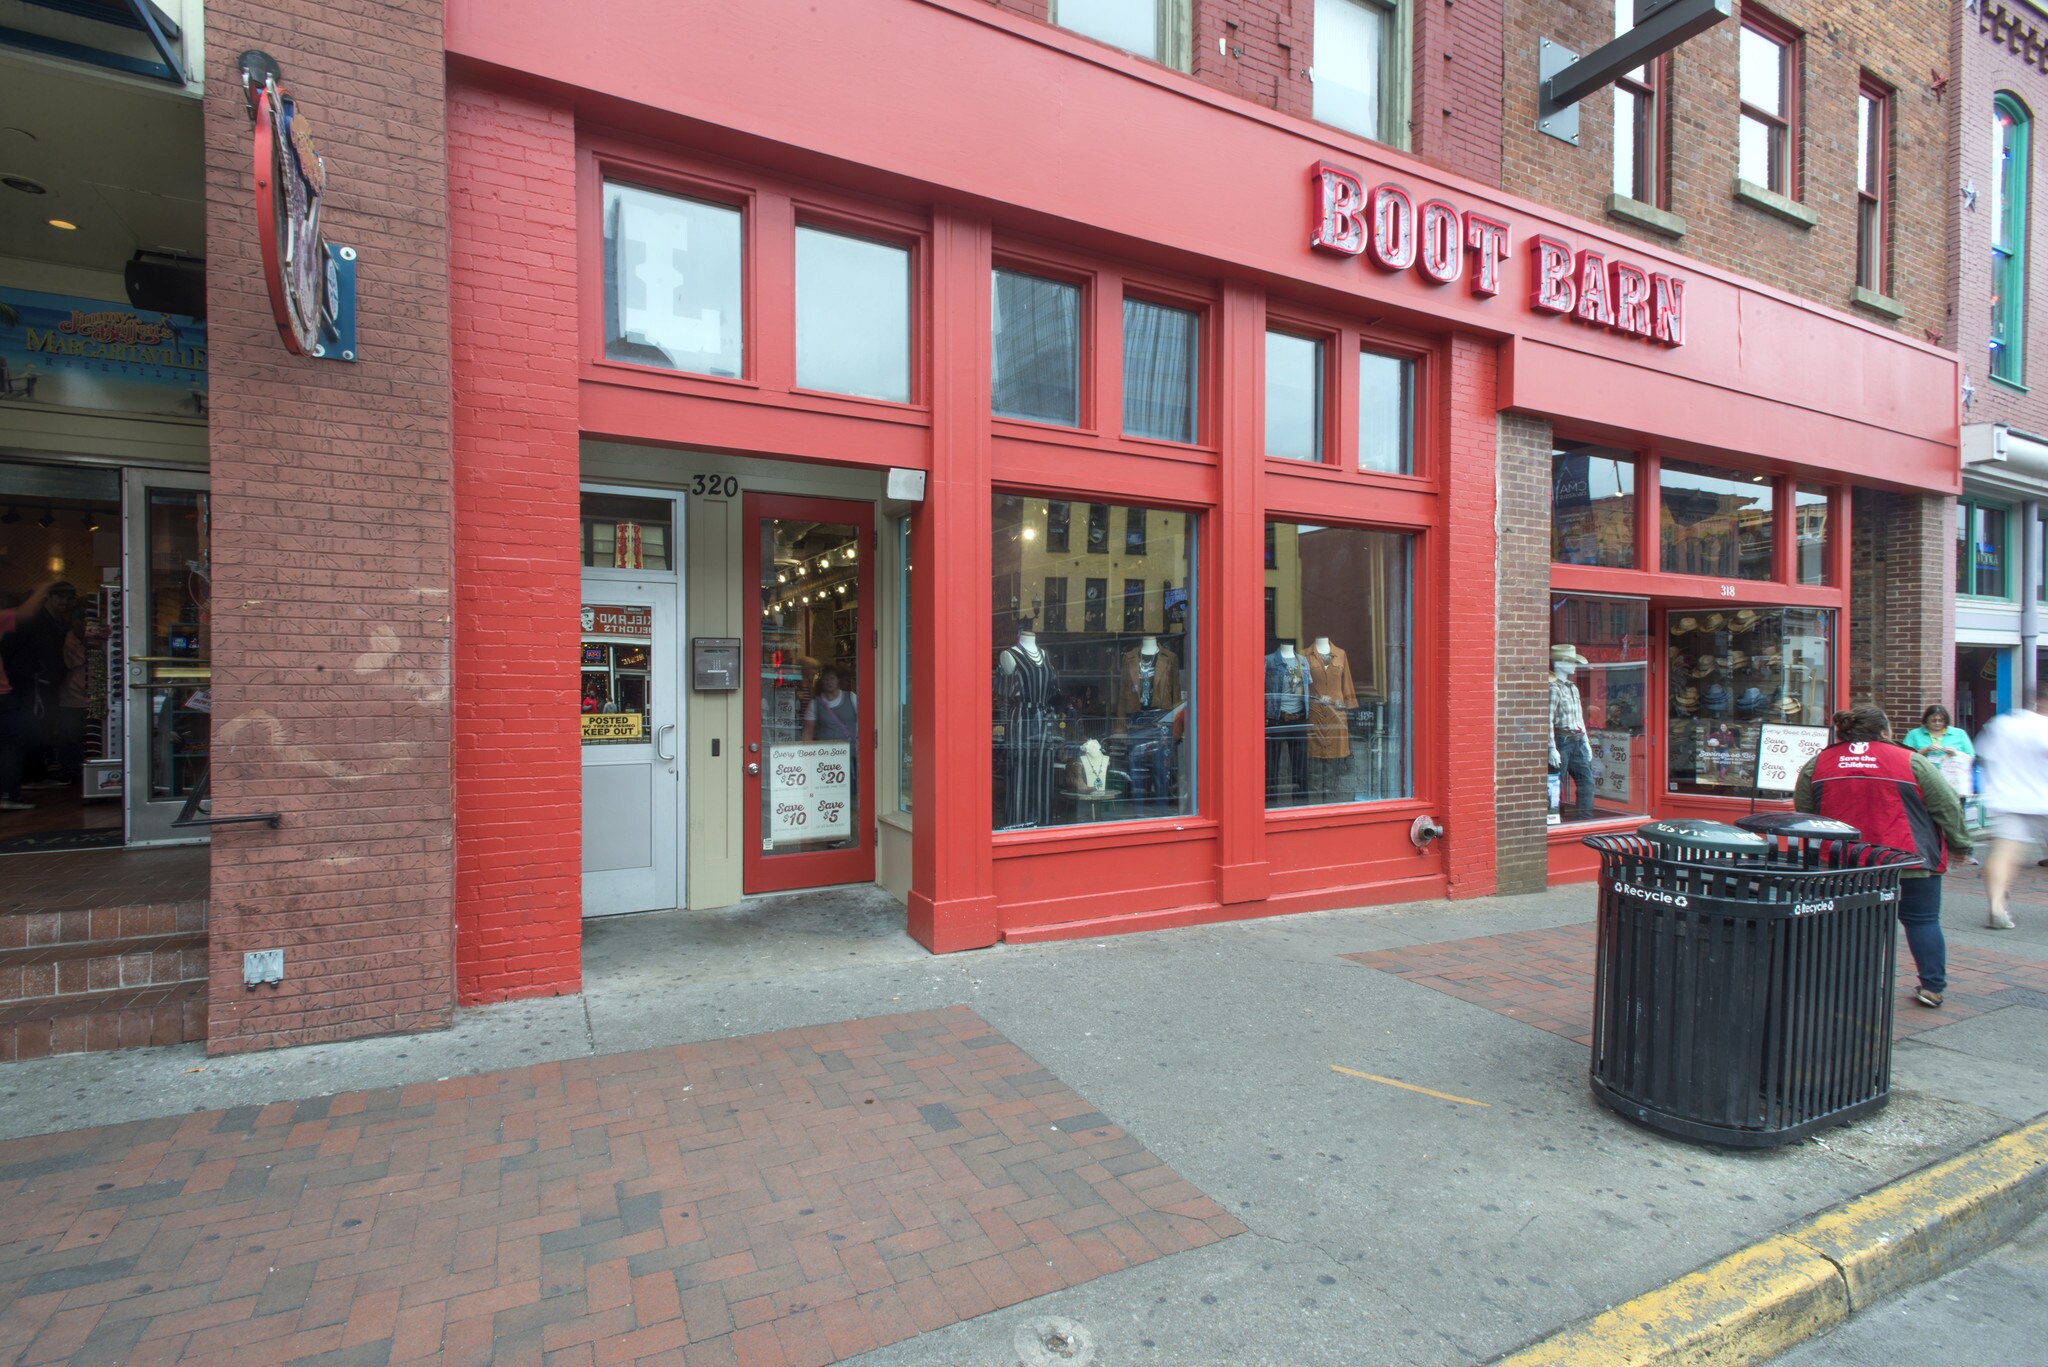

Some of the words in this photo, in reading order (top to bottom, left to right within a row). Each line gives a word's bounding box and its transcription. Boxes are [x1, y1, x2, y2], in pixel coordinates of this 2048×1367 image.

[1311, 159, 1512, 298] BOOT
[1530, 233, 1687, 348] BARN
[59, 310, 136, 335] Jimmy
[26, 327, 208, 372] MARGARITAVILLE
[45, 357, 199, 382] NASHVILLE
[692, 474, 738, 498] 320
[1720, 584, 1735, 597] 318
[773, 750, 795, 759] Every
[797, 749, 816, 758] Boot
[830, 748, 847, 756] Sale
[1593, 750, 1604, 759] 50
[1699, 750, 1730, 759] Savings
[1742, 752, 1756, 760] Big
[1767, 745, 1788, 754] $50
[1612, 752, 1627, 762] $20
[776, 764, 802, 775] Save
[816, 762, 842, 773] Save
[1761, 762, 1784, 770] Save
[781, 773, 806, 786] $50
[821, 771, 845, 784] $20
[1766, 770, 1786, 780] $10
[1595, 777, 1604, 786] 10
[1613, 780, 1623, 789] $5
[776, 803, 804, 814] Save
[817, 800, 844, 811] Save
[783, 812, 806, 826] $10
[823, 810, 839, 823] $5
[1624, 883, 1673, 903] Recycle
[1880, 891, 1895, 901] Trash
[1802, 901, 1827, 914] Recycle
